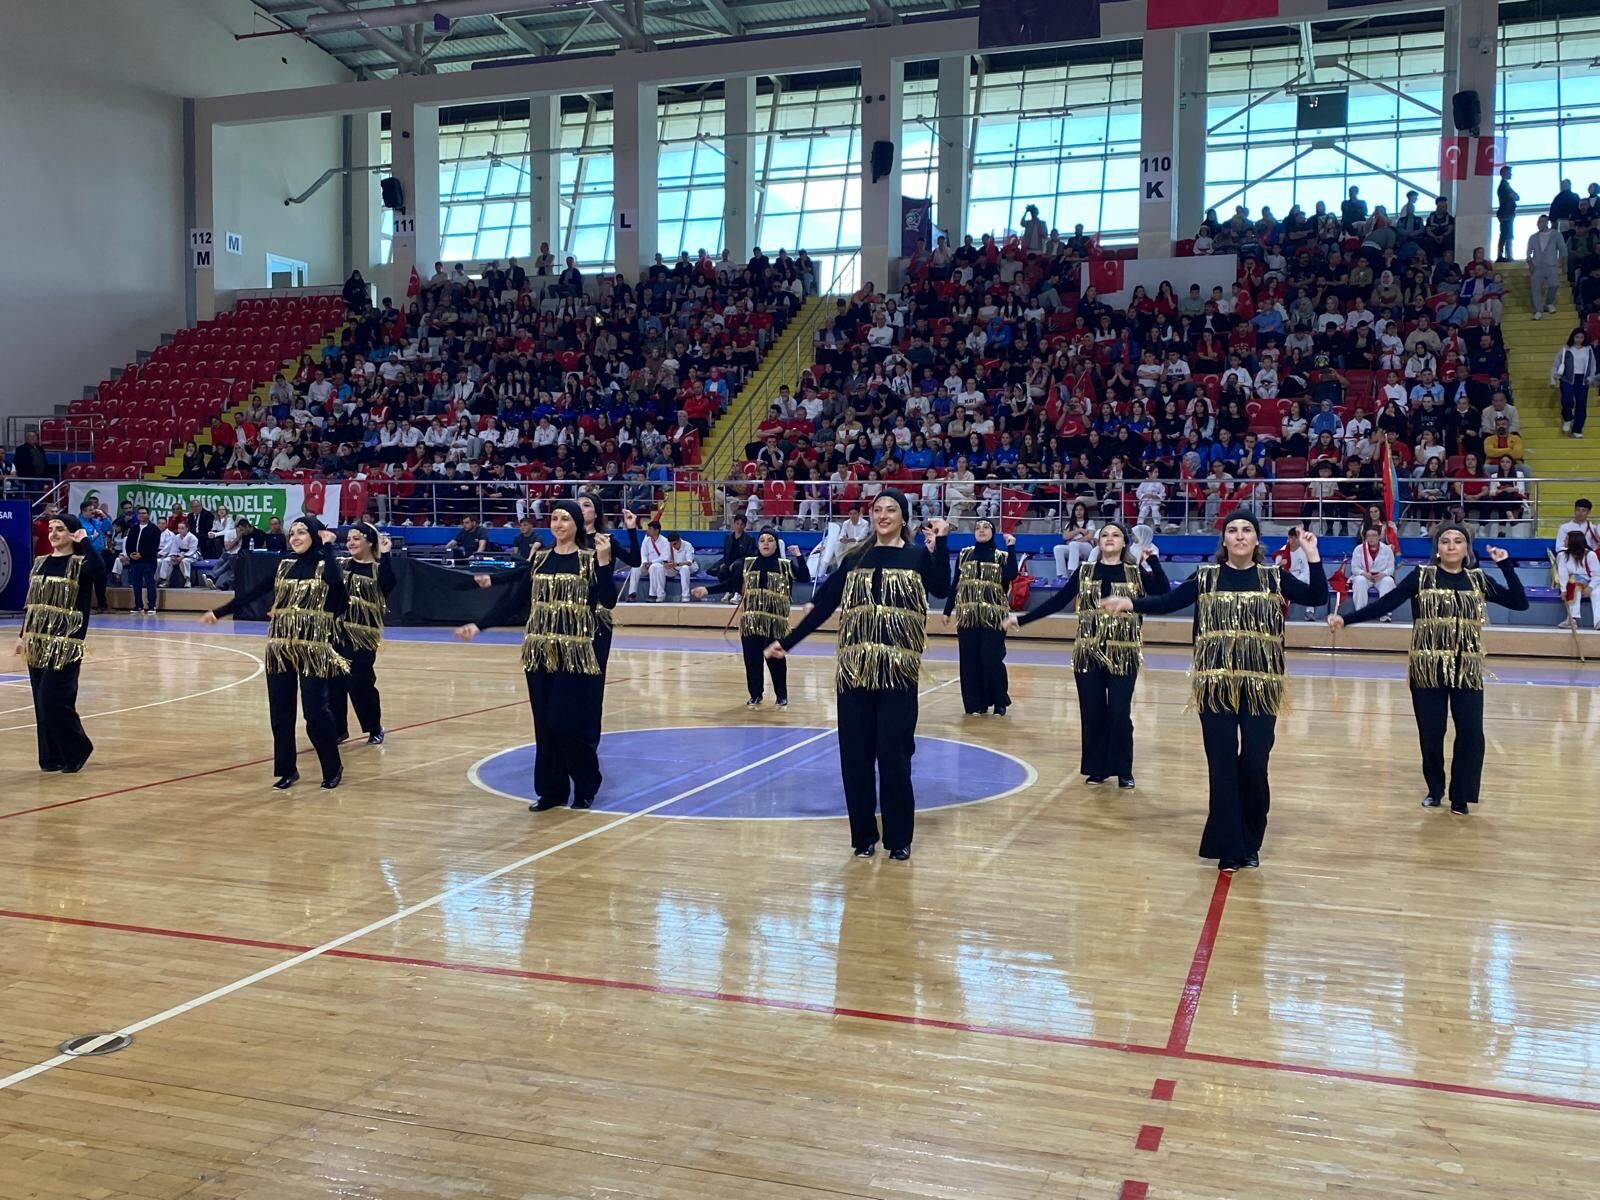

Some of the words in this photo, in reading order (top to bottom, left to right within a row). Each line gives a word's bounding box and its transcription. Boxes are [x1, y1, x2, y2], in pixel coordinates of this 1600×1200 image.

[1141, 156, 1171, 172] 110
[1146, 181, 1164, 199] K
[394, 219, 414, 232] 111
[620, 213, 631, 228] L
[192, 232, 212, 244] 112
[228, 235, 239, 251] M
[197, 251, 210, 265] M
